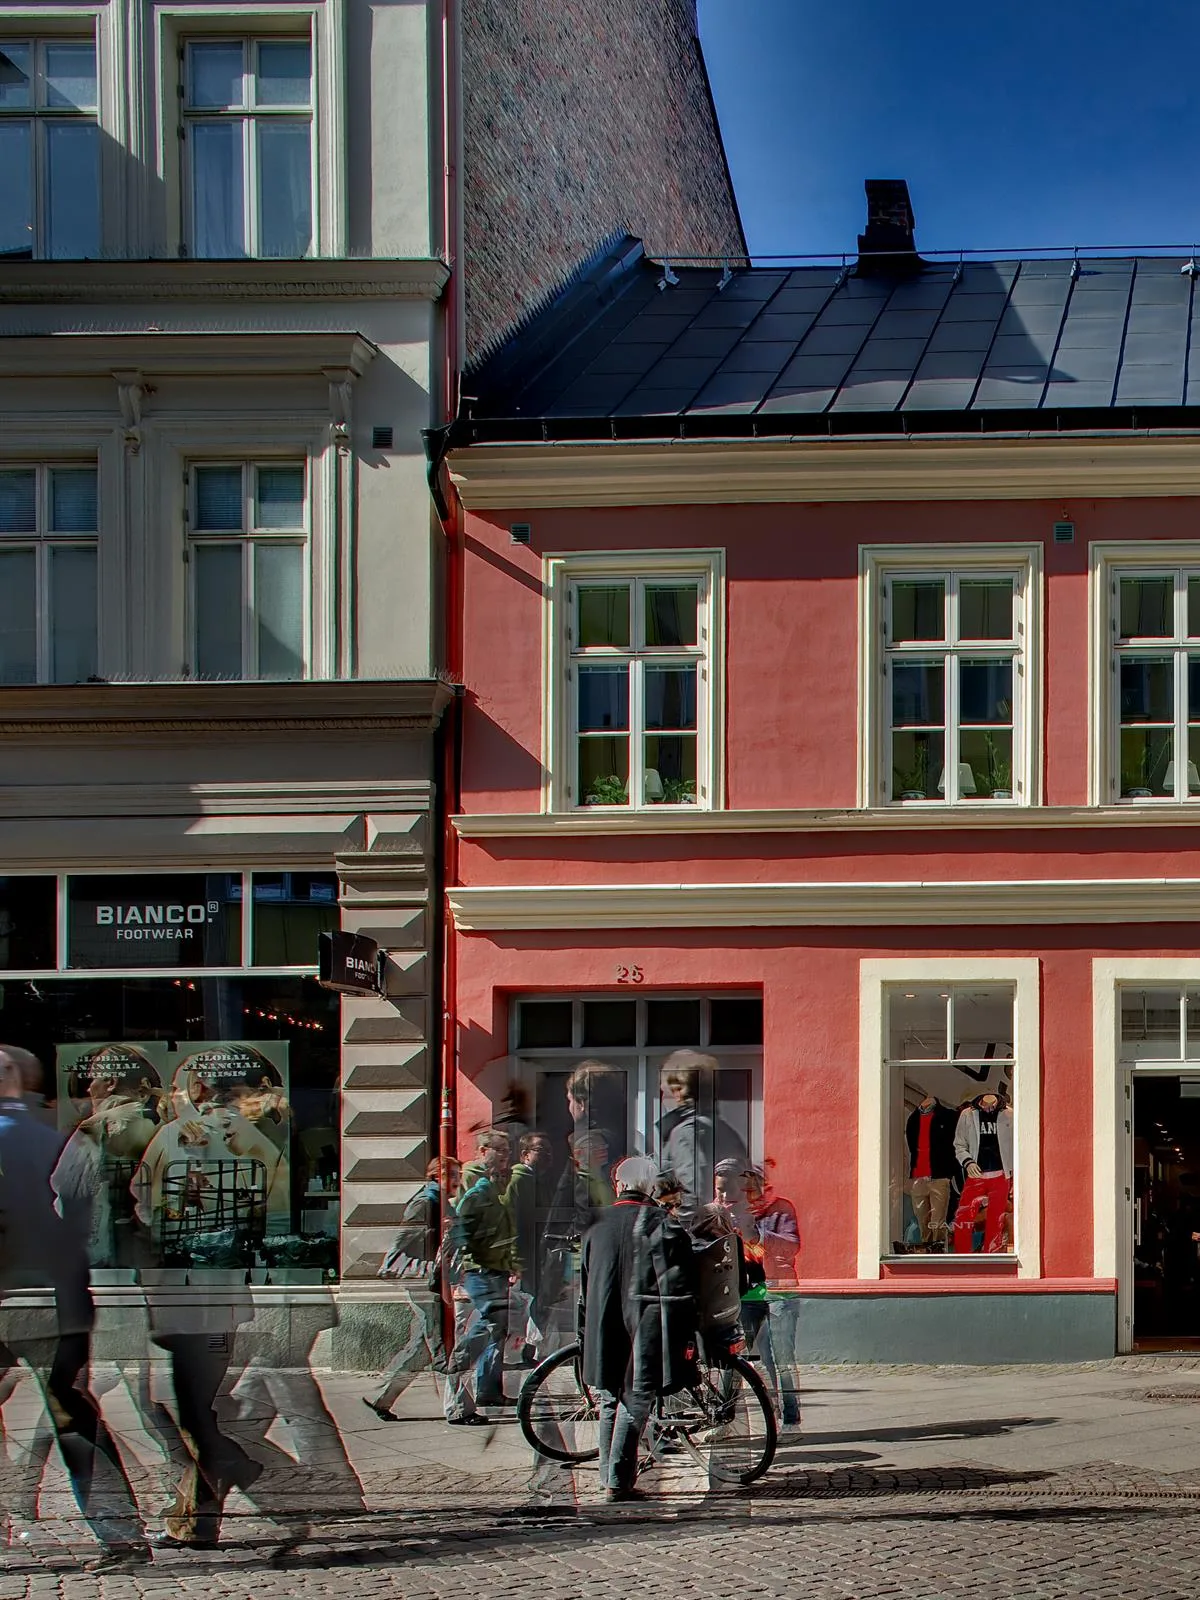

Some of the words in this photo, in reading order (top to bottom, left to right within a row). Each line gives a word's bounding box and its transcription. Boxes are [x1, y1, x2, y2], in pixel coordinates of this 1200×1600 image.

[116, 928, 194, 940] FOOTWEAR
[616, 964, 645, 984] 25
[195, 1054, 250, 1062] GLOBAL
[980, 1121, 998, 1135] AN
[927, 1221, 975, 1231] GANT
